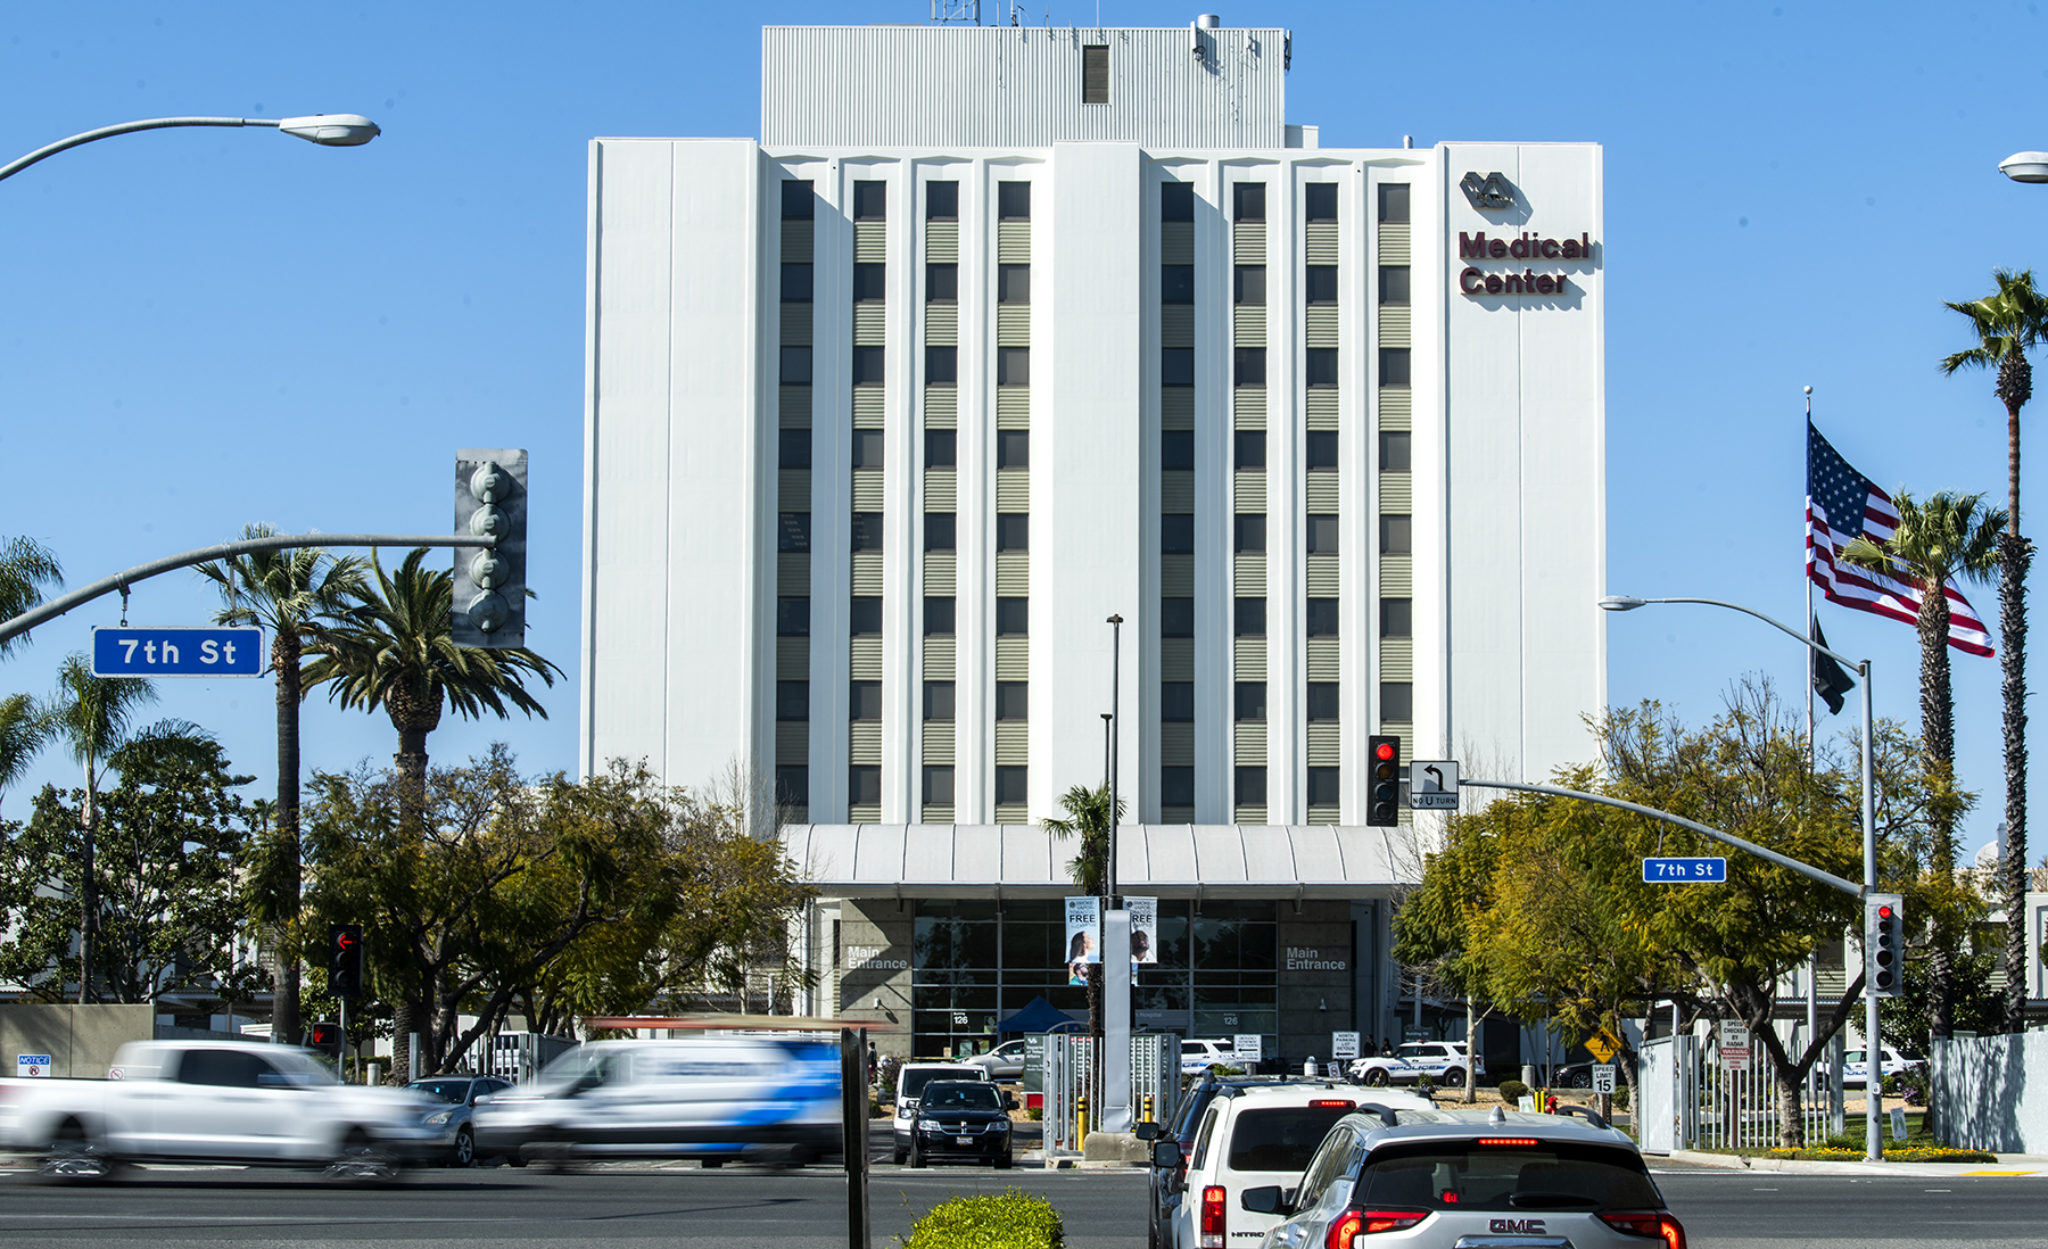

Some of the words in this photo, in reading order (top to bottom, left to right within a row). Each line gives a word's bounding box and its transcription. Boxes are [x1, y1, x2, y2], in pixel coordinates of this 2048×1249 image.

[1459, 231, 1589, 259] Medical
[1459, 266, 1568, 294] Center
[118, 639, 180, 664] 7th
[199, 639, 237, 665] St
[1412, 797, 1423, 805] NO
[1425, 796, 1434, 806] U
[1655, 863, 1686, 877] 7th
[1694, 863, 1713, 877] St
[1069, 914, 1096, 923] FREE
[1132, 914, 1152, 923] REE
[848, 946, 880, 958] Main
[1286, 946, 1319, 958] Main
[848, 958, 908, 969] Entrance
[1286, 958, 1346, 970] Entrance
[20, 1056, 49, 1065] NOTICE
[1596, 1080, 1612, 1091] 15
[1489, 1219, 1546, 1234] GMC
